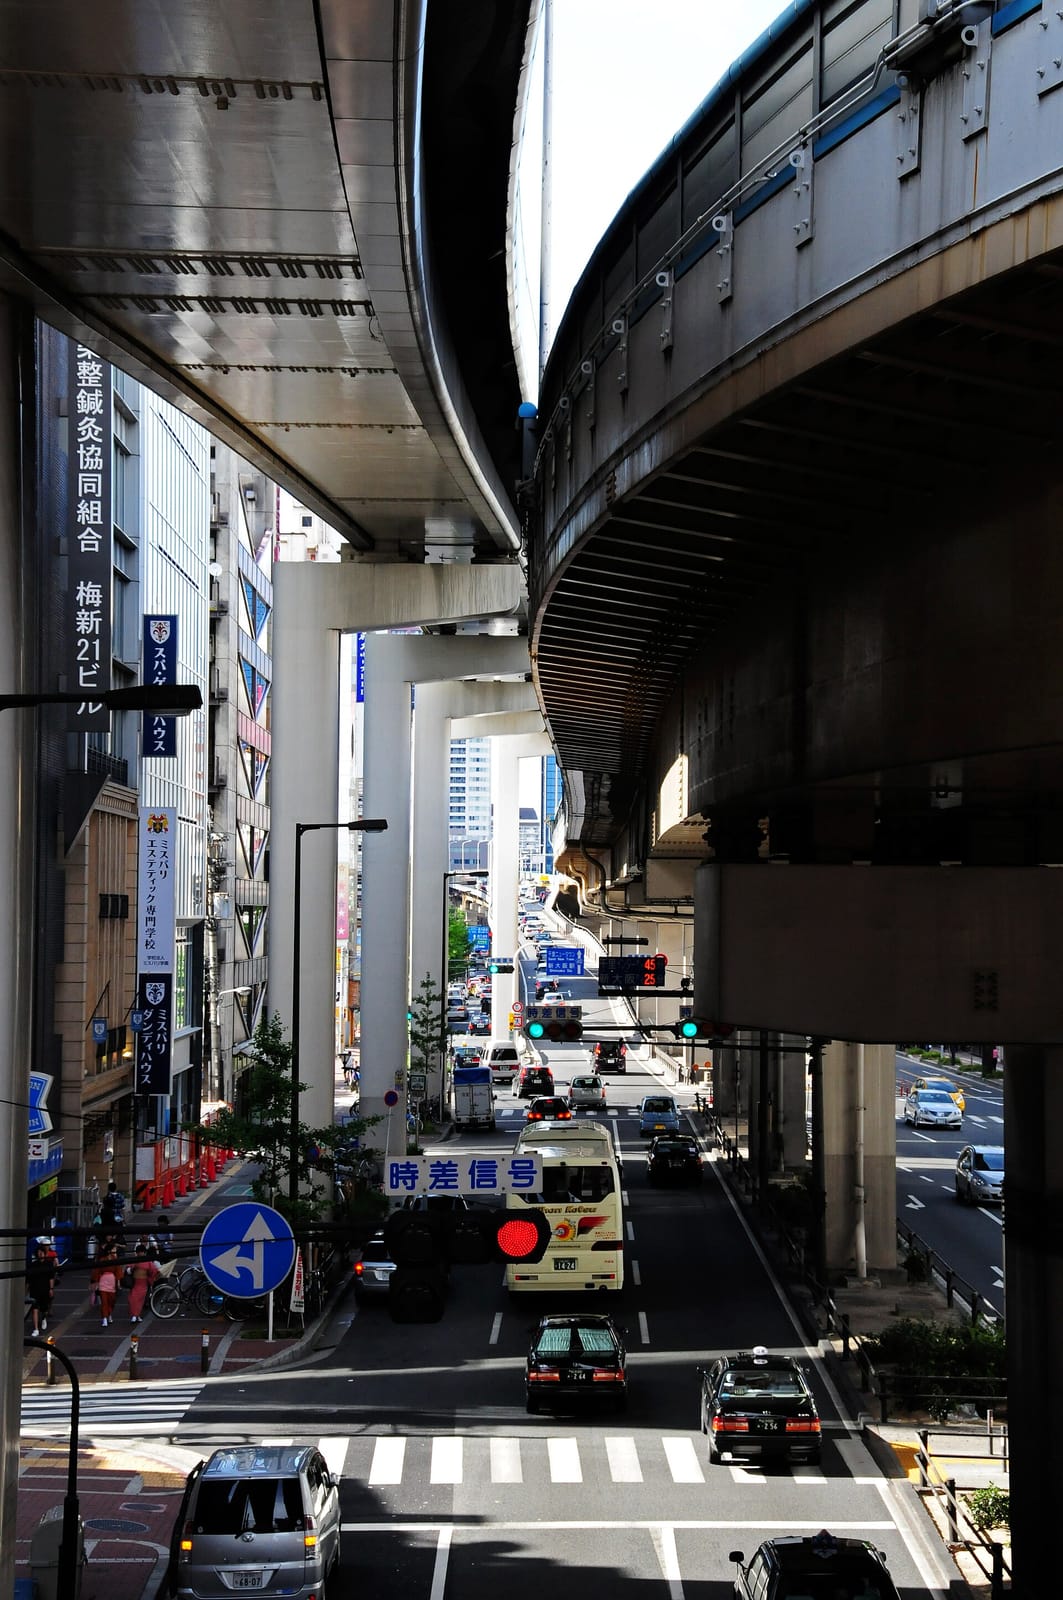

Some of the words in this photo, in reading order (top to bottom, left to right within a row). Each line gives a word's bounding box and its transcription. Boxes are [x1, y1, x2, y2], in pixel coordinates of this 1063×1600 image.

[76, 581, 104, 716] 梅新21ビル
[152, 647, 168, 752] スパ・ゲハウス
[159, 839, 169, 880] ミスパリ
[144, 839, 158, 951] エステティック専門学校
[643, 958, 657, 971] 45
[643, 973, 657, 985] 25
[155, 1008, 168, 1056] ミスパリ
[527, 1007, 580, 1018] 時差信号
[140, 1008, 155, 1085] ダンディハウス
[390, 1160, 538, 1190] 時差信号
